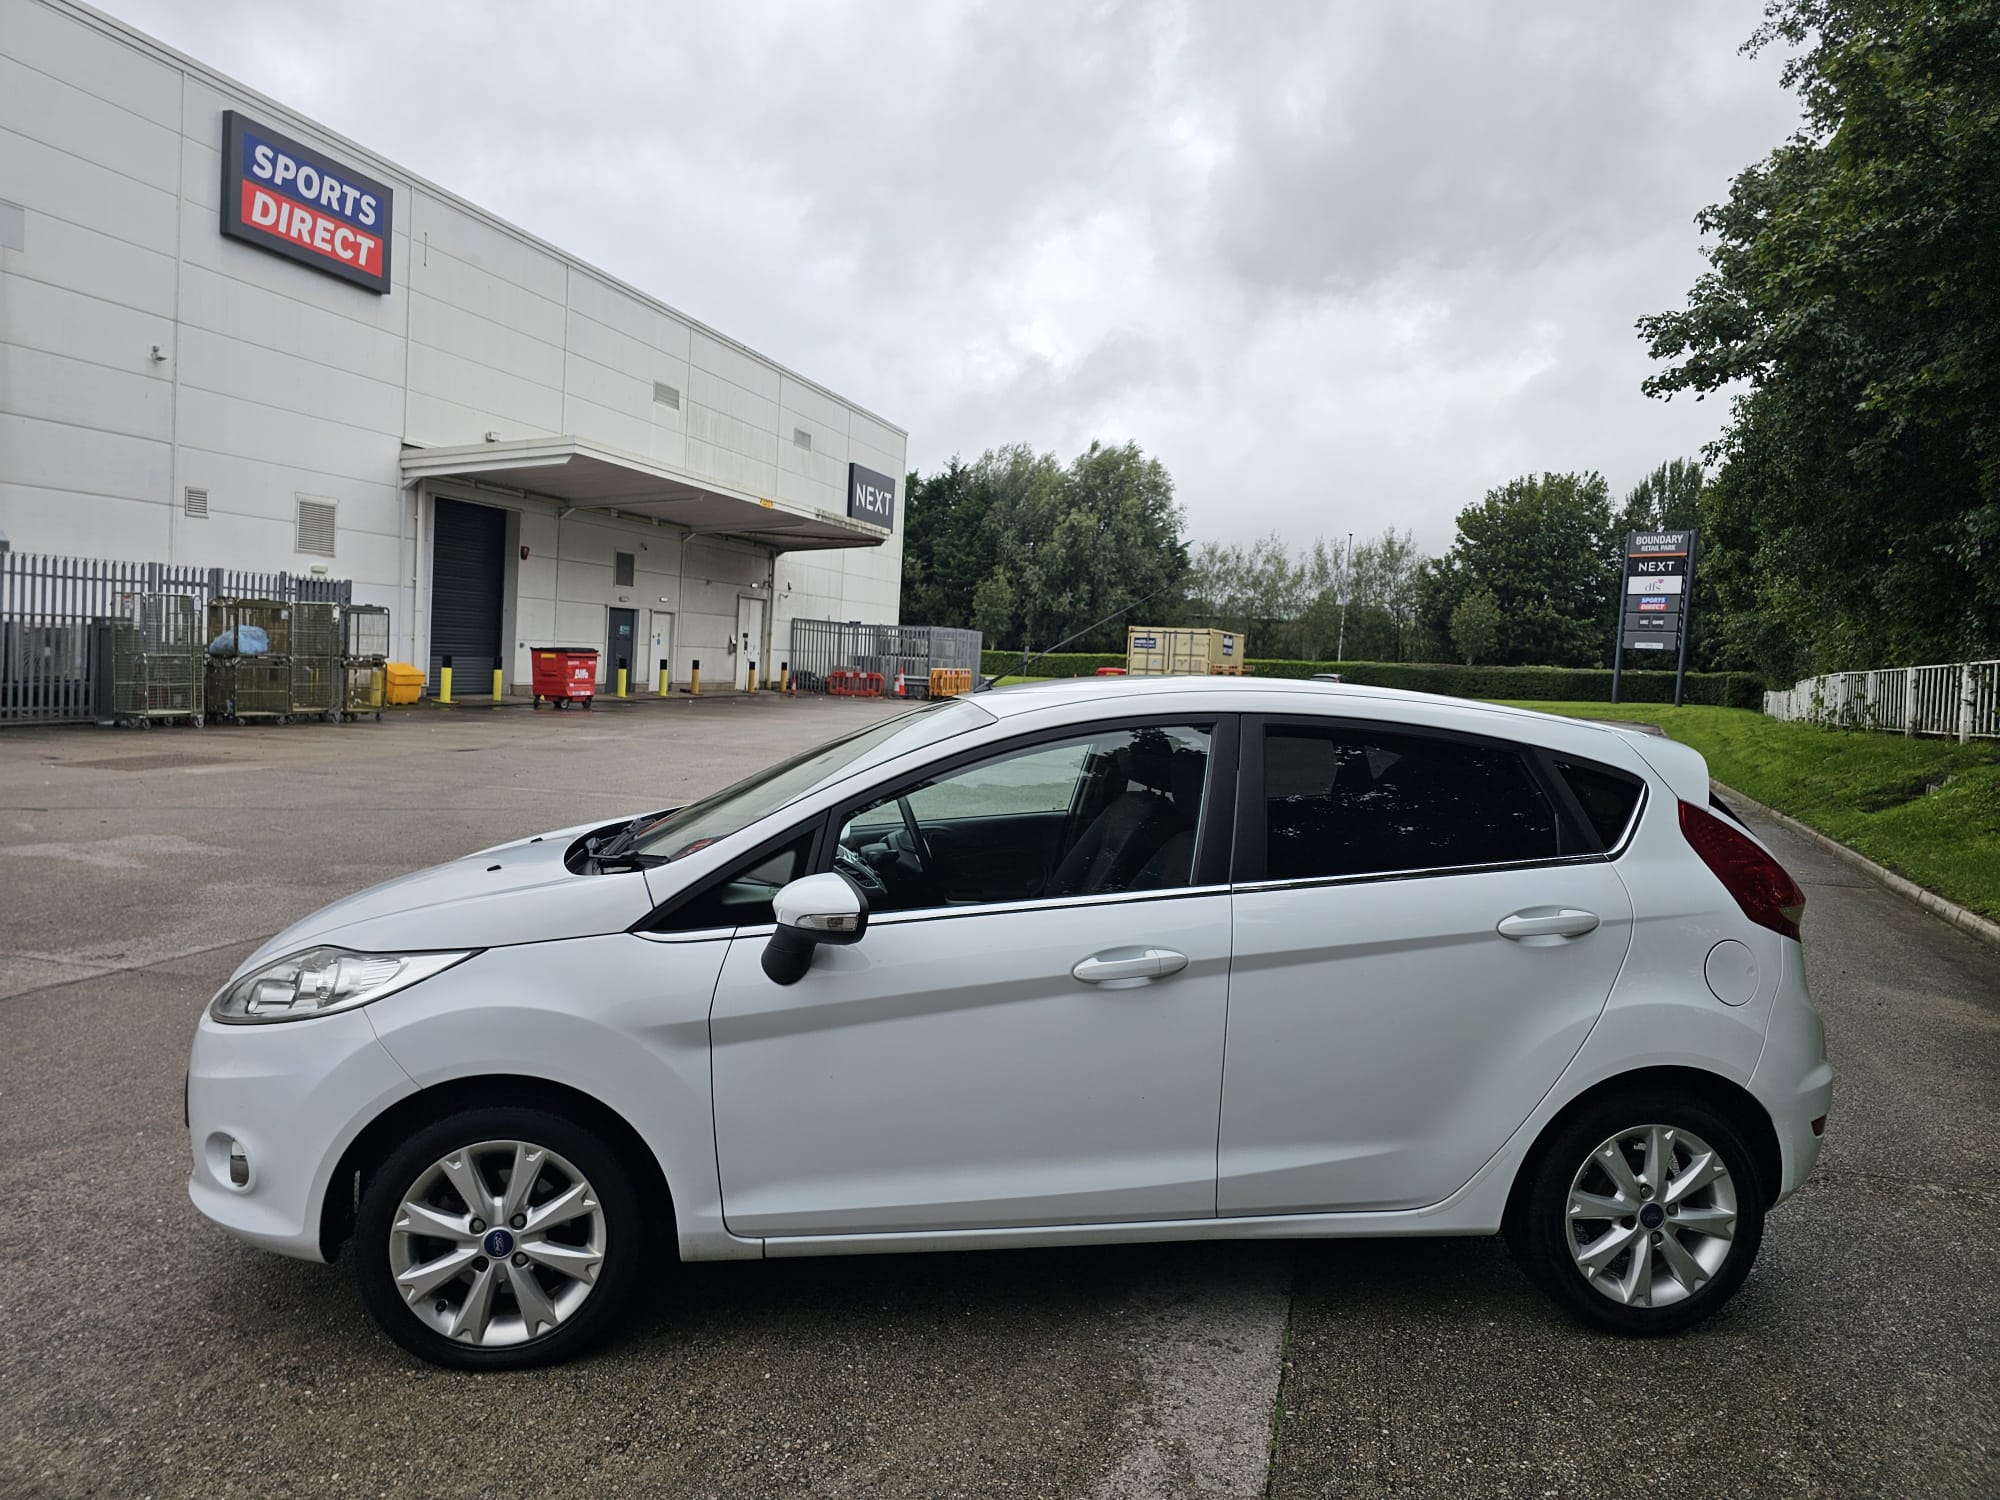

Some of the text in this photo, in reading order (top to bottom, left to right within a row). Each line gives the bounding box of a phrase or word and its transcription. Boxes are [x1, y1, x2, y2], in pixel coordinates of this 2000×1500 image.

[252, 145, 376, 226] SPORTS
[251, 191, 375, 266] DIRECT
[856, 482, 892, 516] NEXT
[1636, 534, 1683, 545] BOUNDARY
[1638, 561, 1675, 572] NEXT
